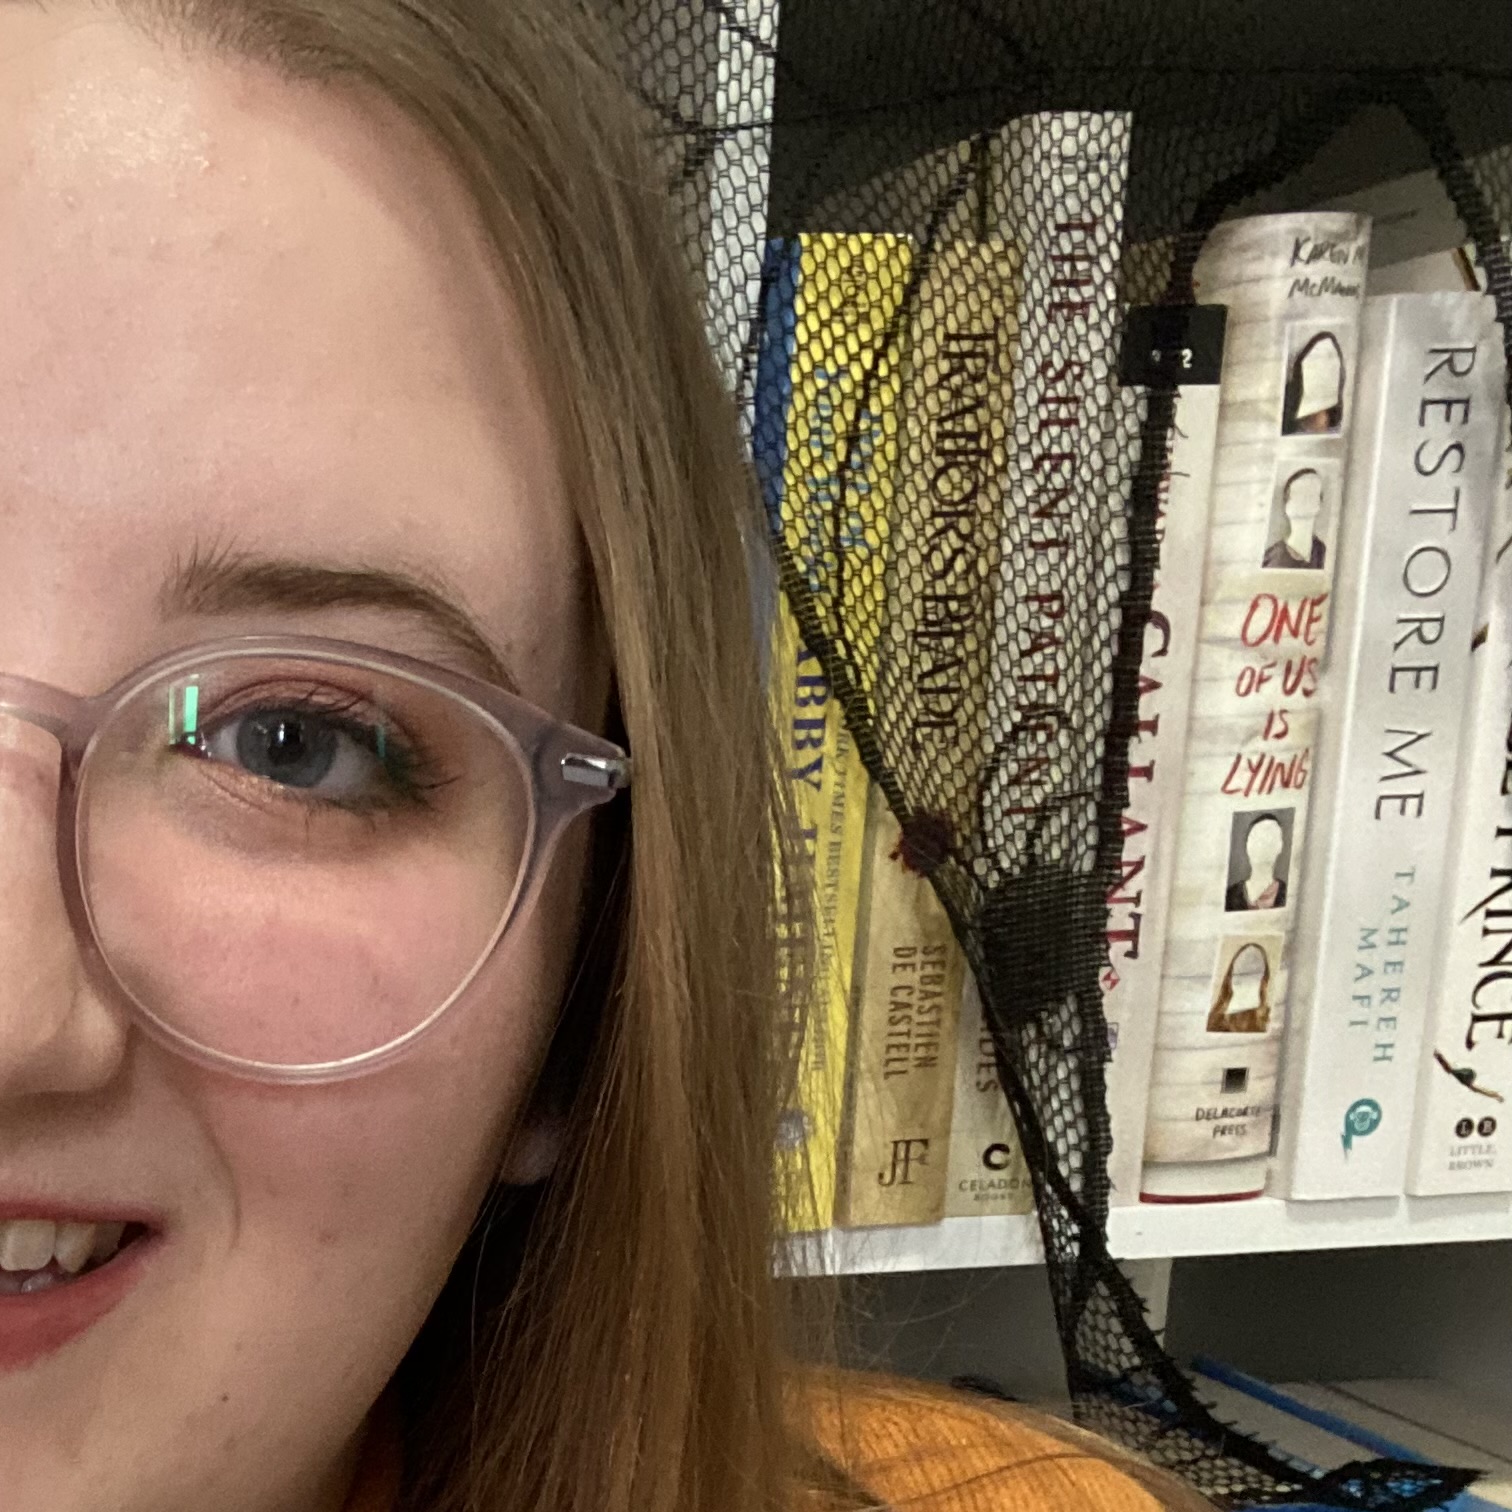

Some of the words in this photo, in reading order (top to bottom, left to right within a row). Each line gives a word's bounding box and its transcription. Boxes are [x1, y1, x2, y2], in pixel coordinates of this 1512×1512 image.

[1389, 344, 1478, 695] RESTORE
[1240, 592, 1329, 648] ONE
[1235, 661, 1278, 698] OF
[1281, 654, 1320, 699] US
[1262, 708, 1290, 741] IS
[1220, 747, 1310, 798] LYING
[1374, 727, 1433, 821] ME
[891, 946, 918, 975] DE
[1348, 926, 1380, 1028] MAFI
[1372, 864, 1416, 1063] TAHEREH
[1458, 823, 1512, 1053] RINCE
[883, 985, 915, 1081] CASTELL
[914, 943, 947, 1070] SEBASTIEN
[982, 1142, 1011, 1171] C
